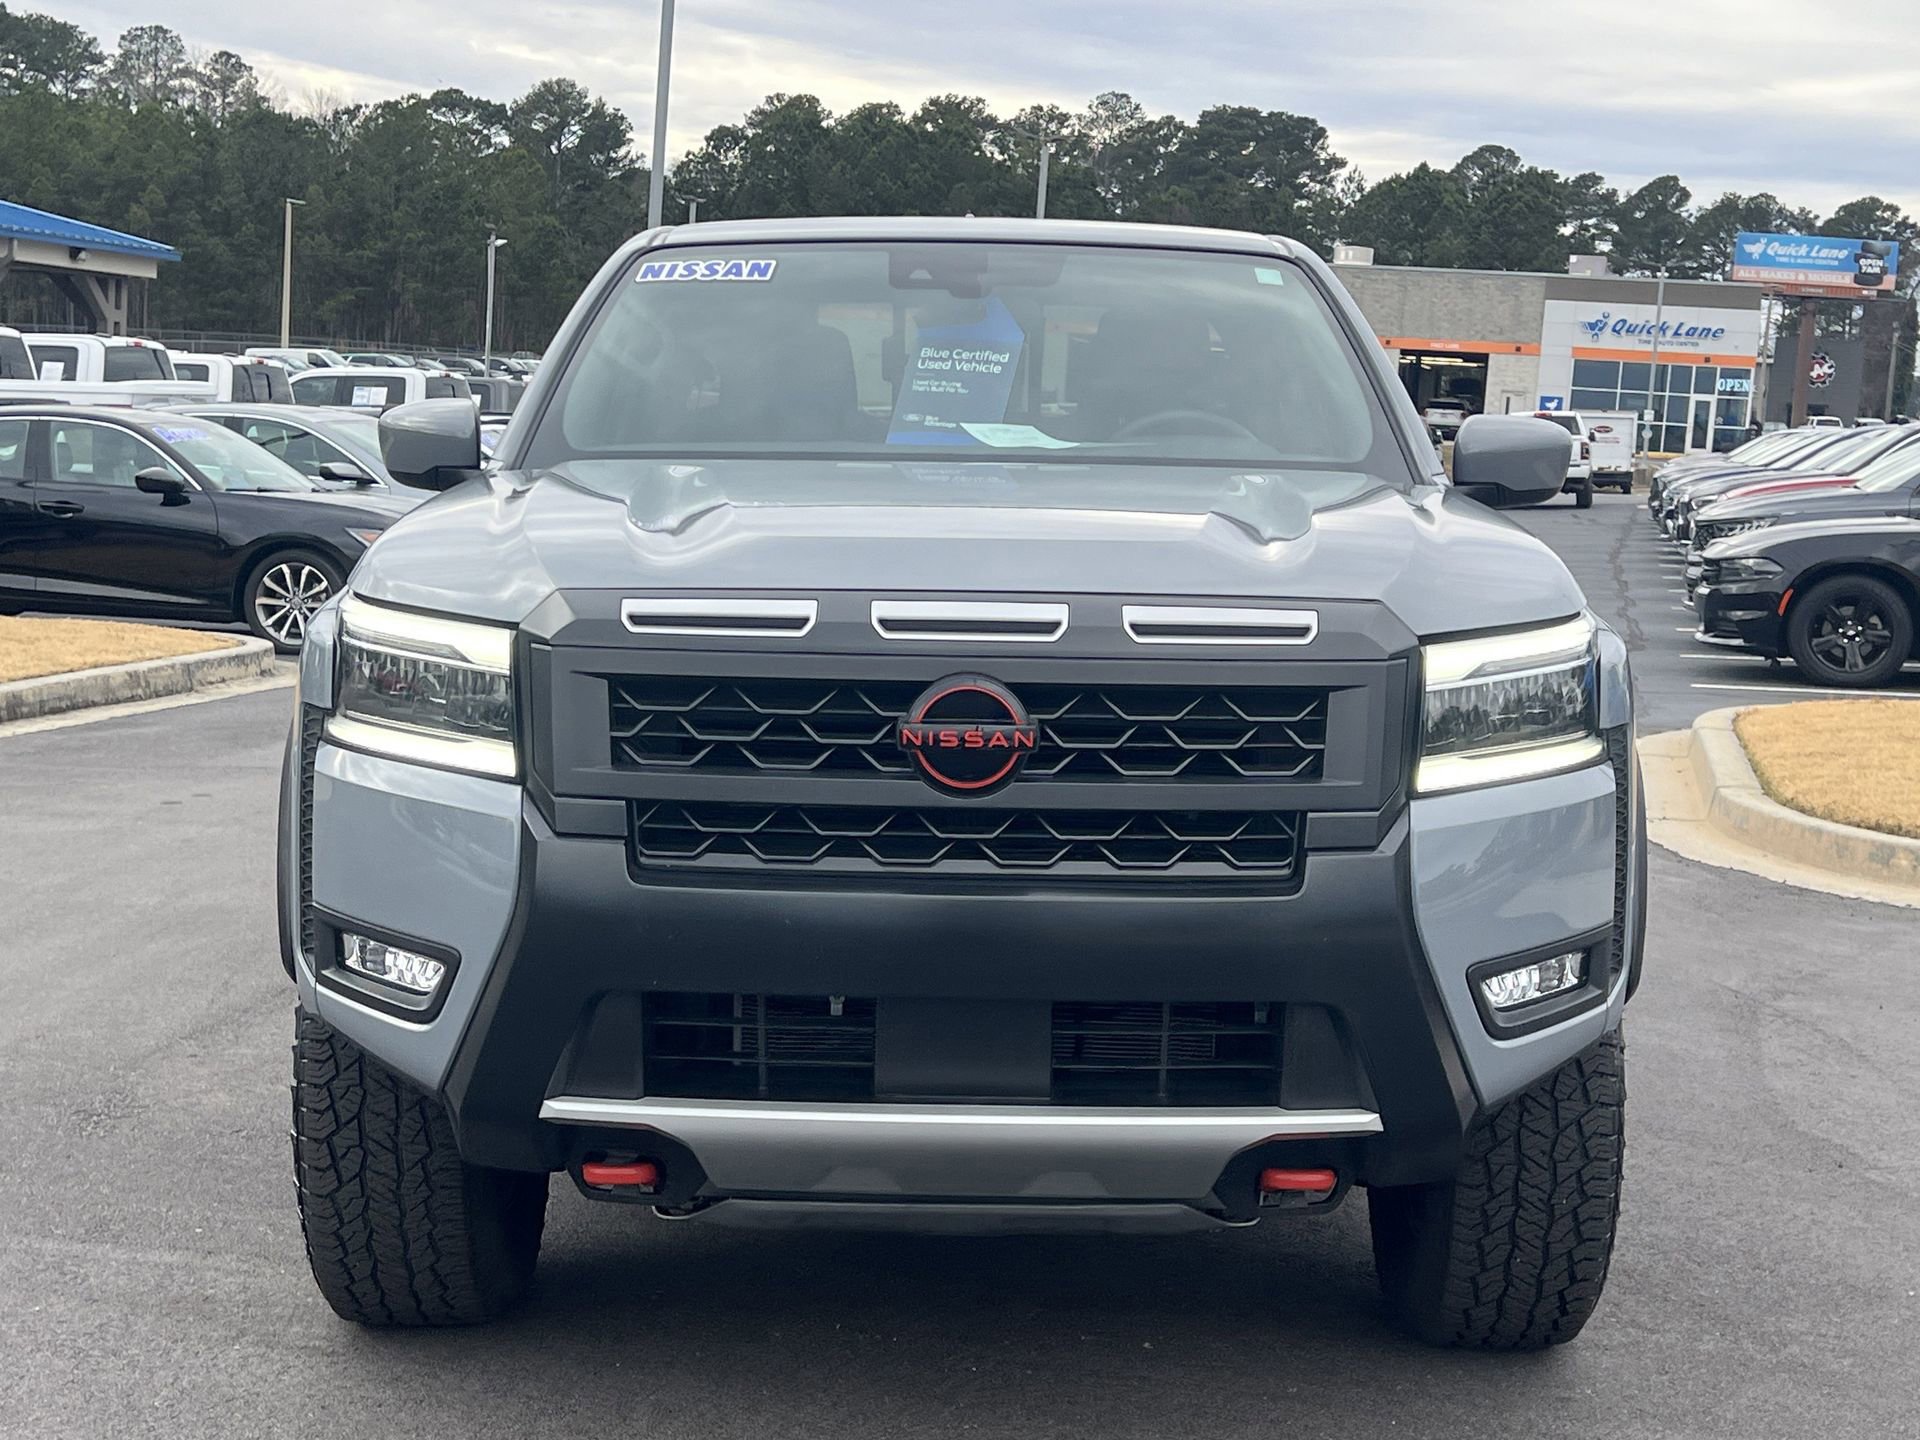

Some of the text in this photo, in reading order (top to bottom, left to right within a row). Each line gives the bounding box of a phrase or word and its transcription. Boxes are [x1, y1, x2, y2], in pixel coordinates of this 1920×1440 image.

[1766, 241, 1848, 259] Quick Lane
[637, 260, 775, 281] NISSAN
[1859, 258, 1883, 268] OPEN
[1860, 265, 1881, 274] 7AM
[1738, 269, 1850, 284] ALL MAKES & MODELS
[1611, 318, 1725, 340] Quick Lane
[920, 347, 1010, 363] Blue Certified
[918, 359, 1002, 374] Used Vehicle
[1717, 378, 1750, 392] OPEN
[901, 729, 1034, 749] NISSAN
